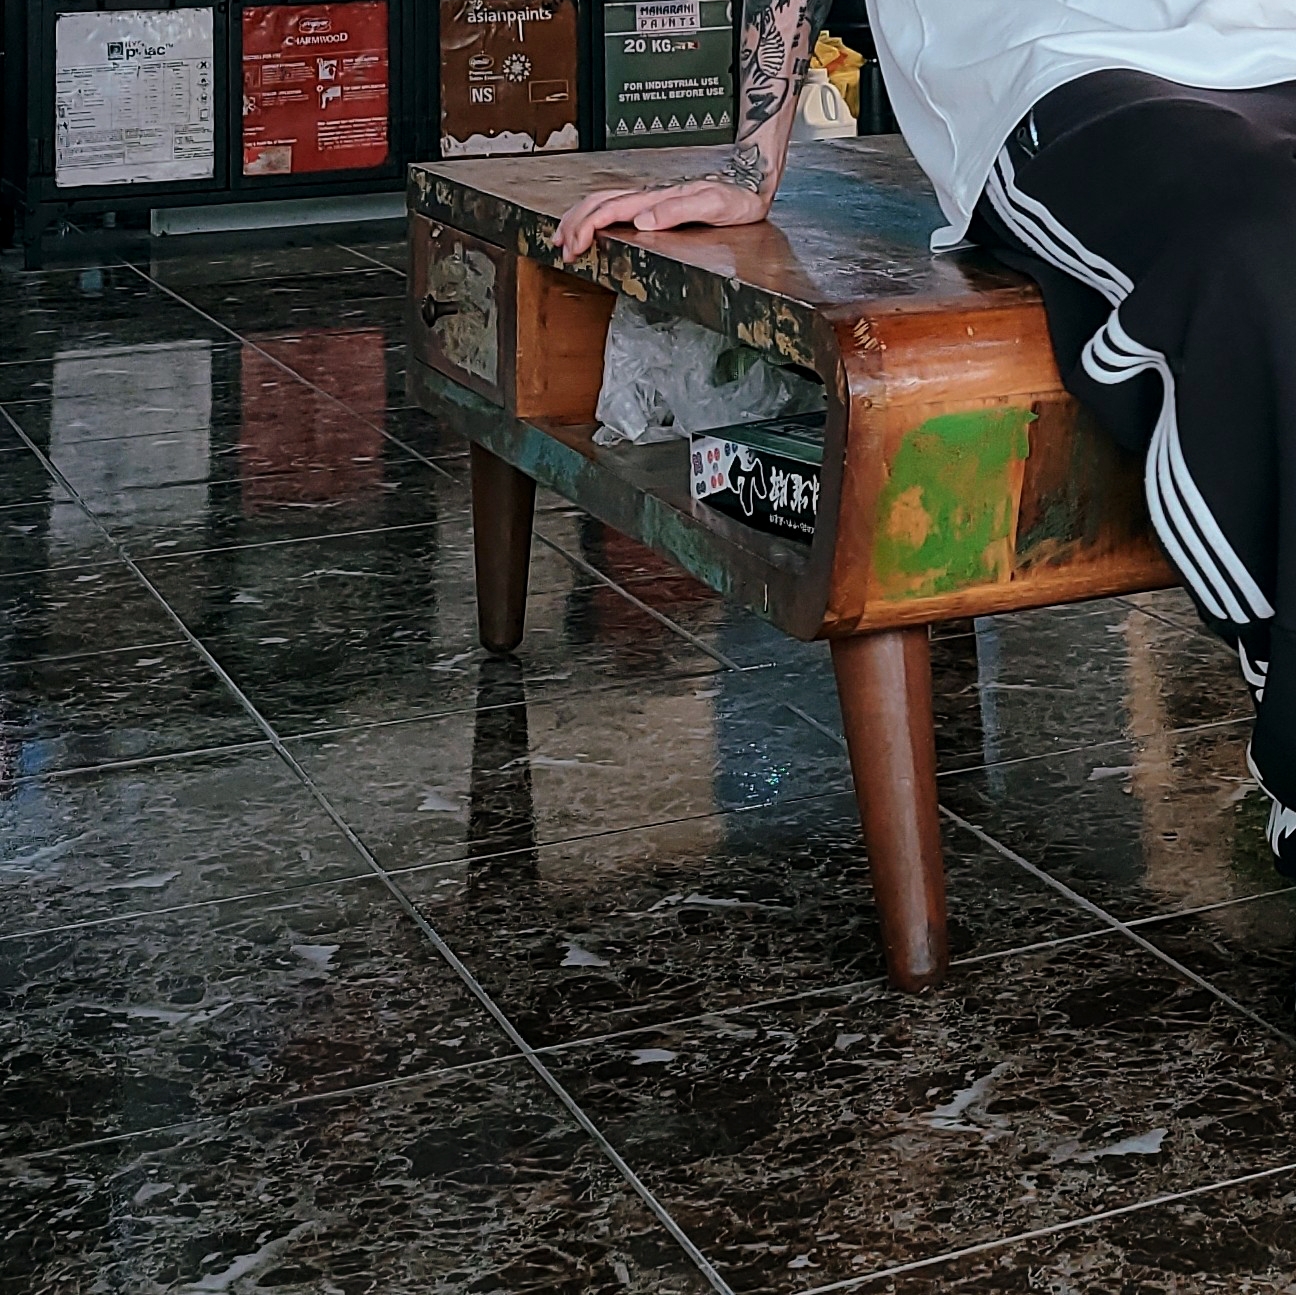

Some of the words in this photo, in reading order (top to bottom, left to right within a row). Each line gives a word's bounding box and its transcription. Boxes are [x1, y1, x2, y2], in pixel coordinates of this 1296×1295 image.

[467, 6, 552, 27] asianpaints
[640, 4, 694, 16] MAHARANI
[640, 17, 695, 29] PAINTS
[624, 39, 646, 53] 20
[624, 82, 642, 91] FOR
[645, 78, 699, 90] INDUSTRIAL
[701, 77, 719, 86] USE
[471, 87, 493, 103] NS
[619, 93, 640, 102] STIR
[642, 91, 667, 101] WELL
[669, 88, 704, 99] BEFORE
[706, 87, 724, 96] USE
